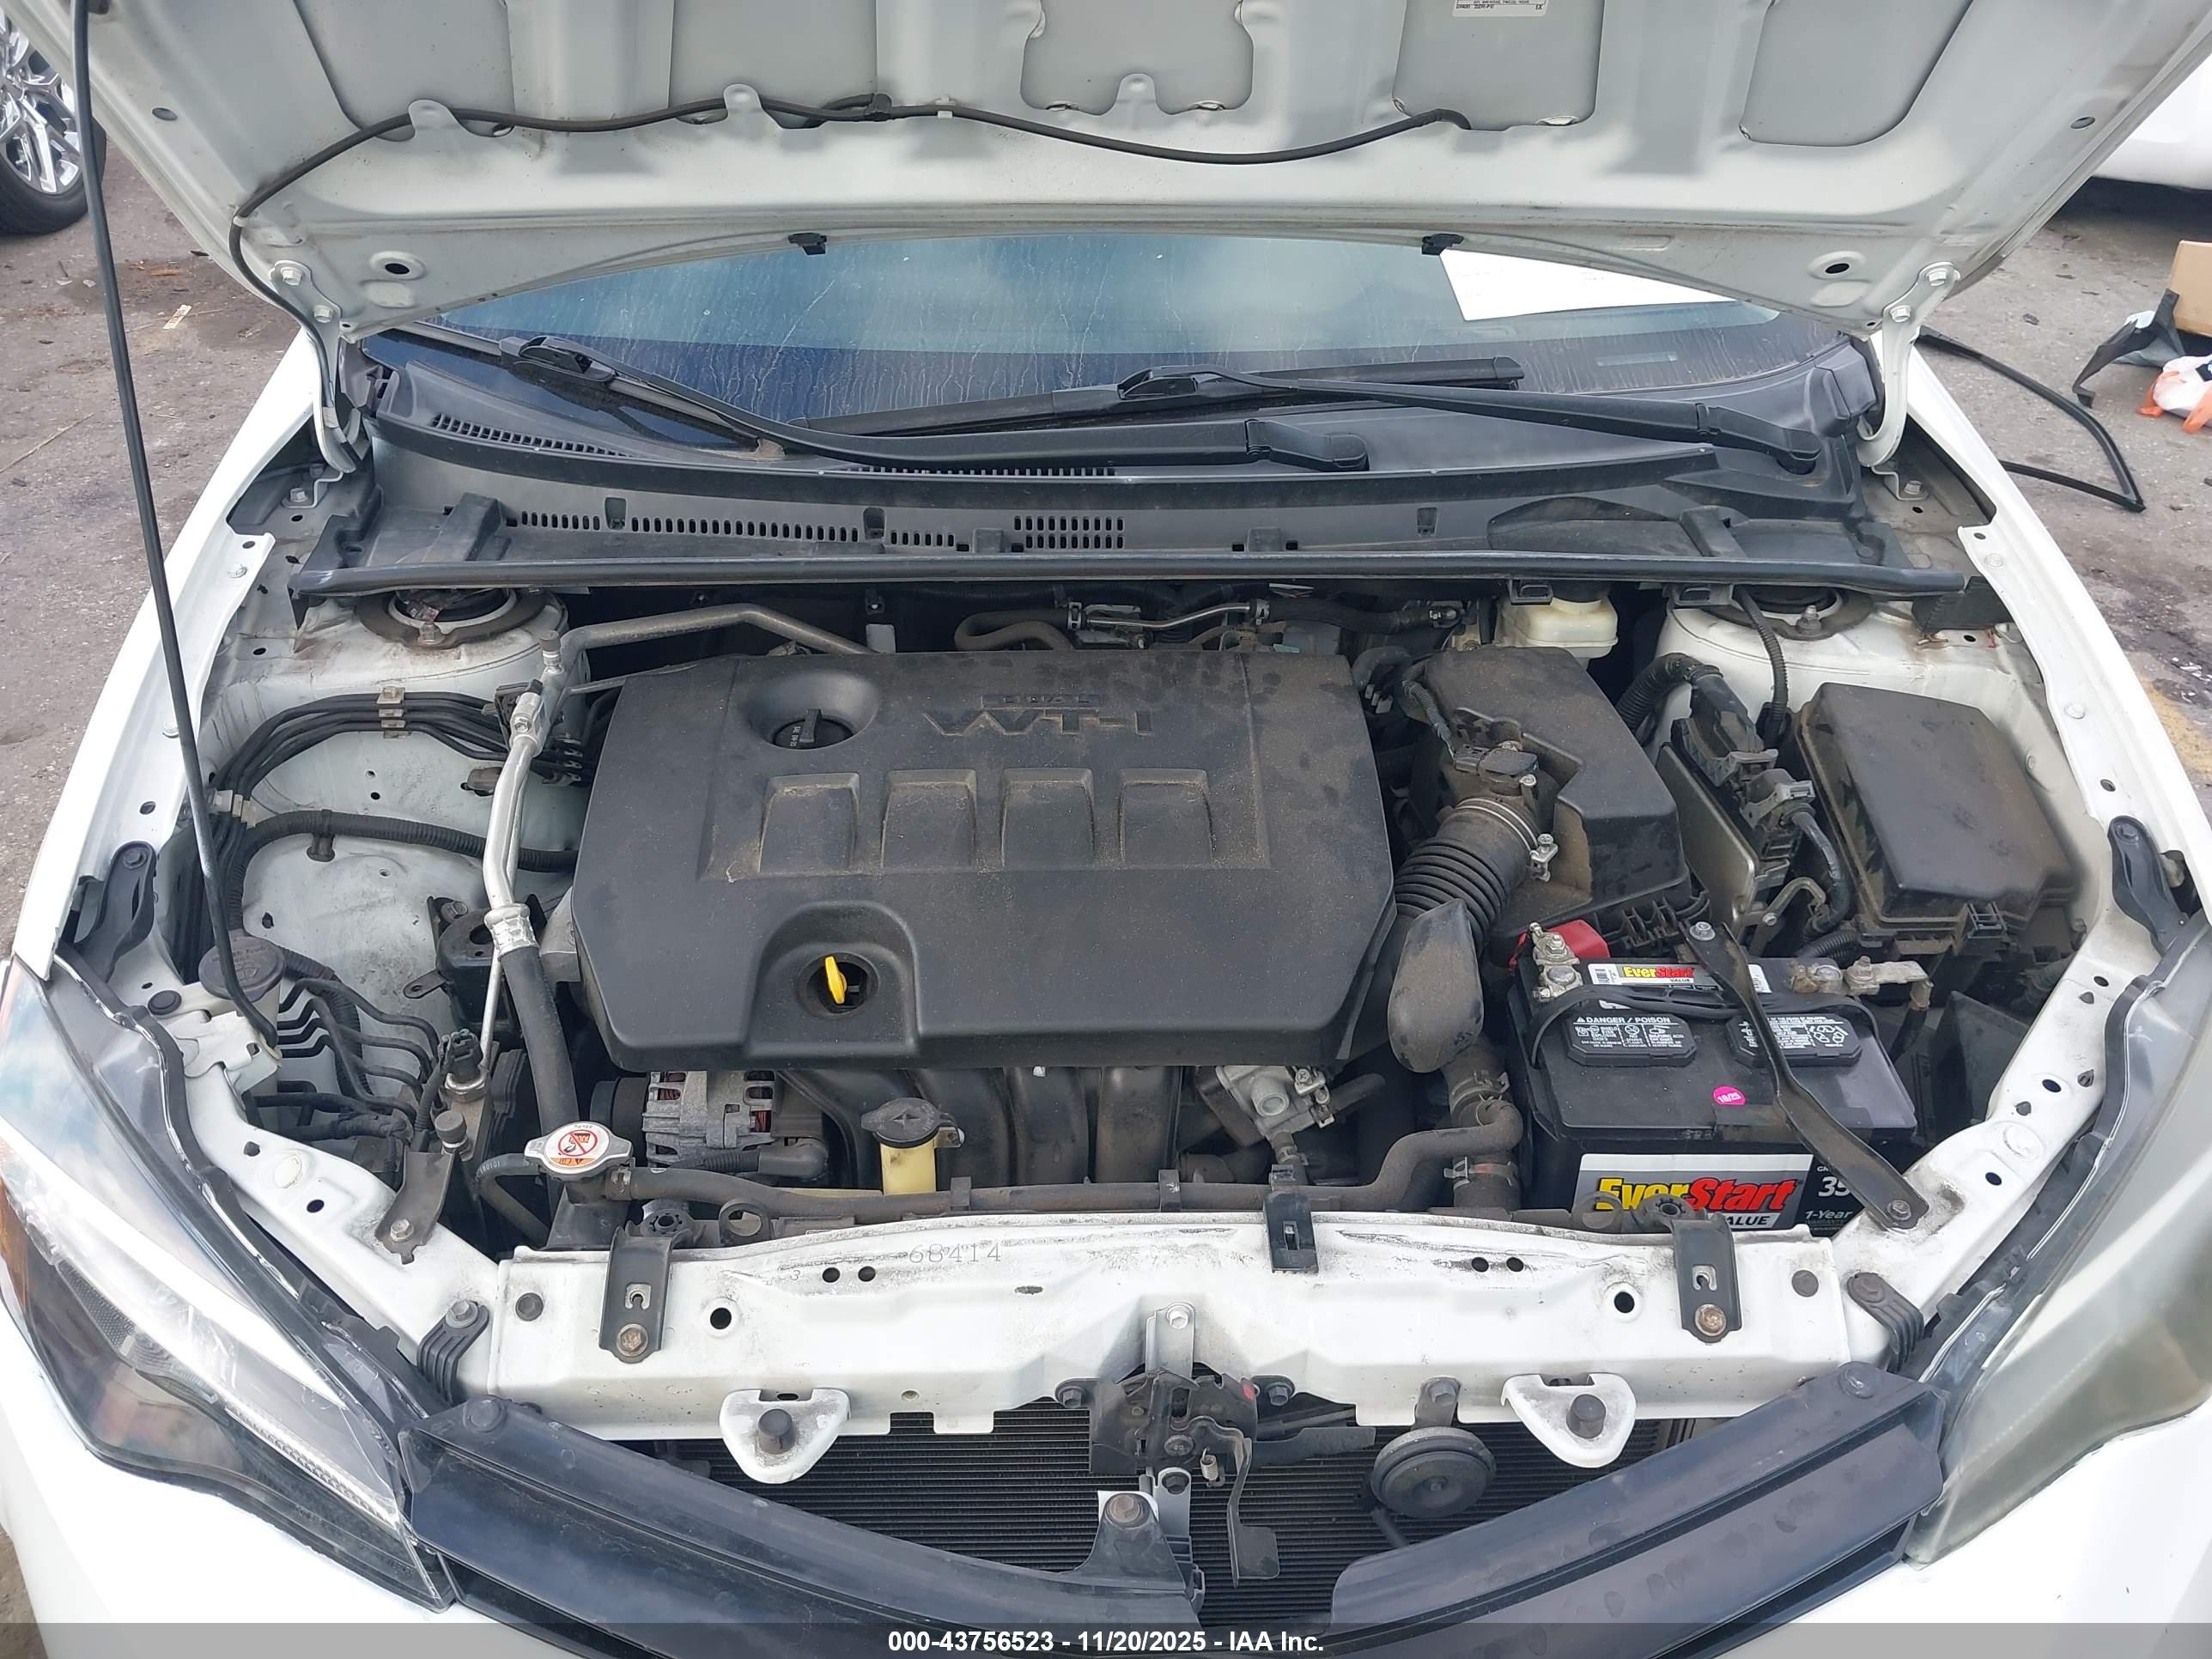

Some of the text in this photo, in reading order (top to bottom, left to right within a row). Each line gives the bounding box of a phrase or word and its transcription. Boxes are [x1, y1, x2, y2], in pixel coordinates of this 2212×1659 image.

[1622, 966, 1694, 978] EverStart
[1806, 1210, 1853, 1219] 1-Year
[908, 1243, 1002, 1264] 68414
